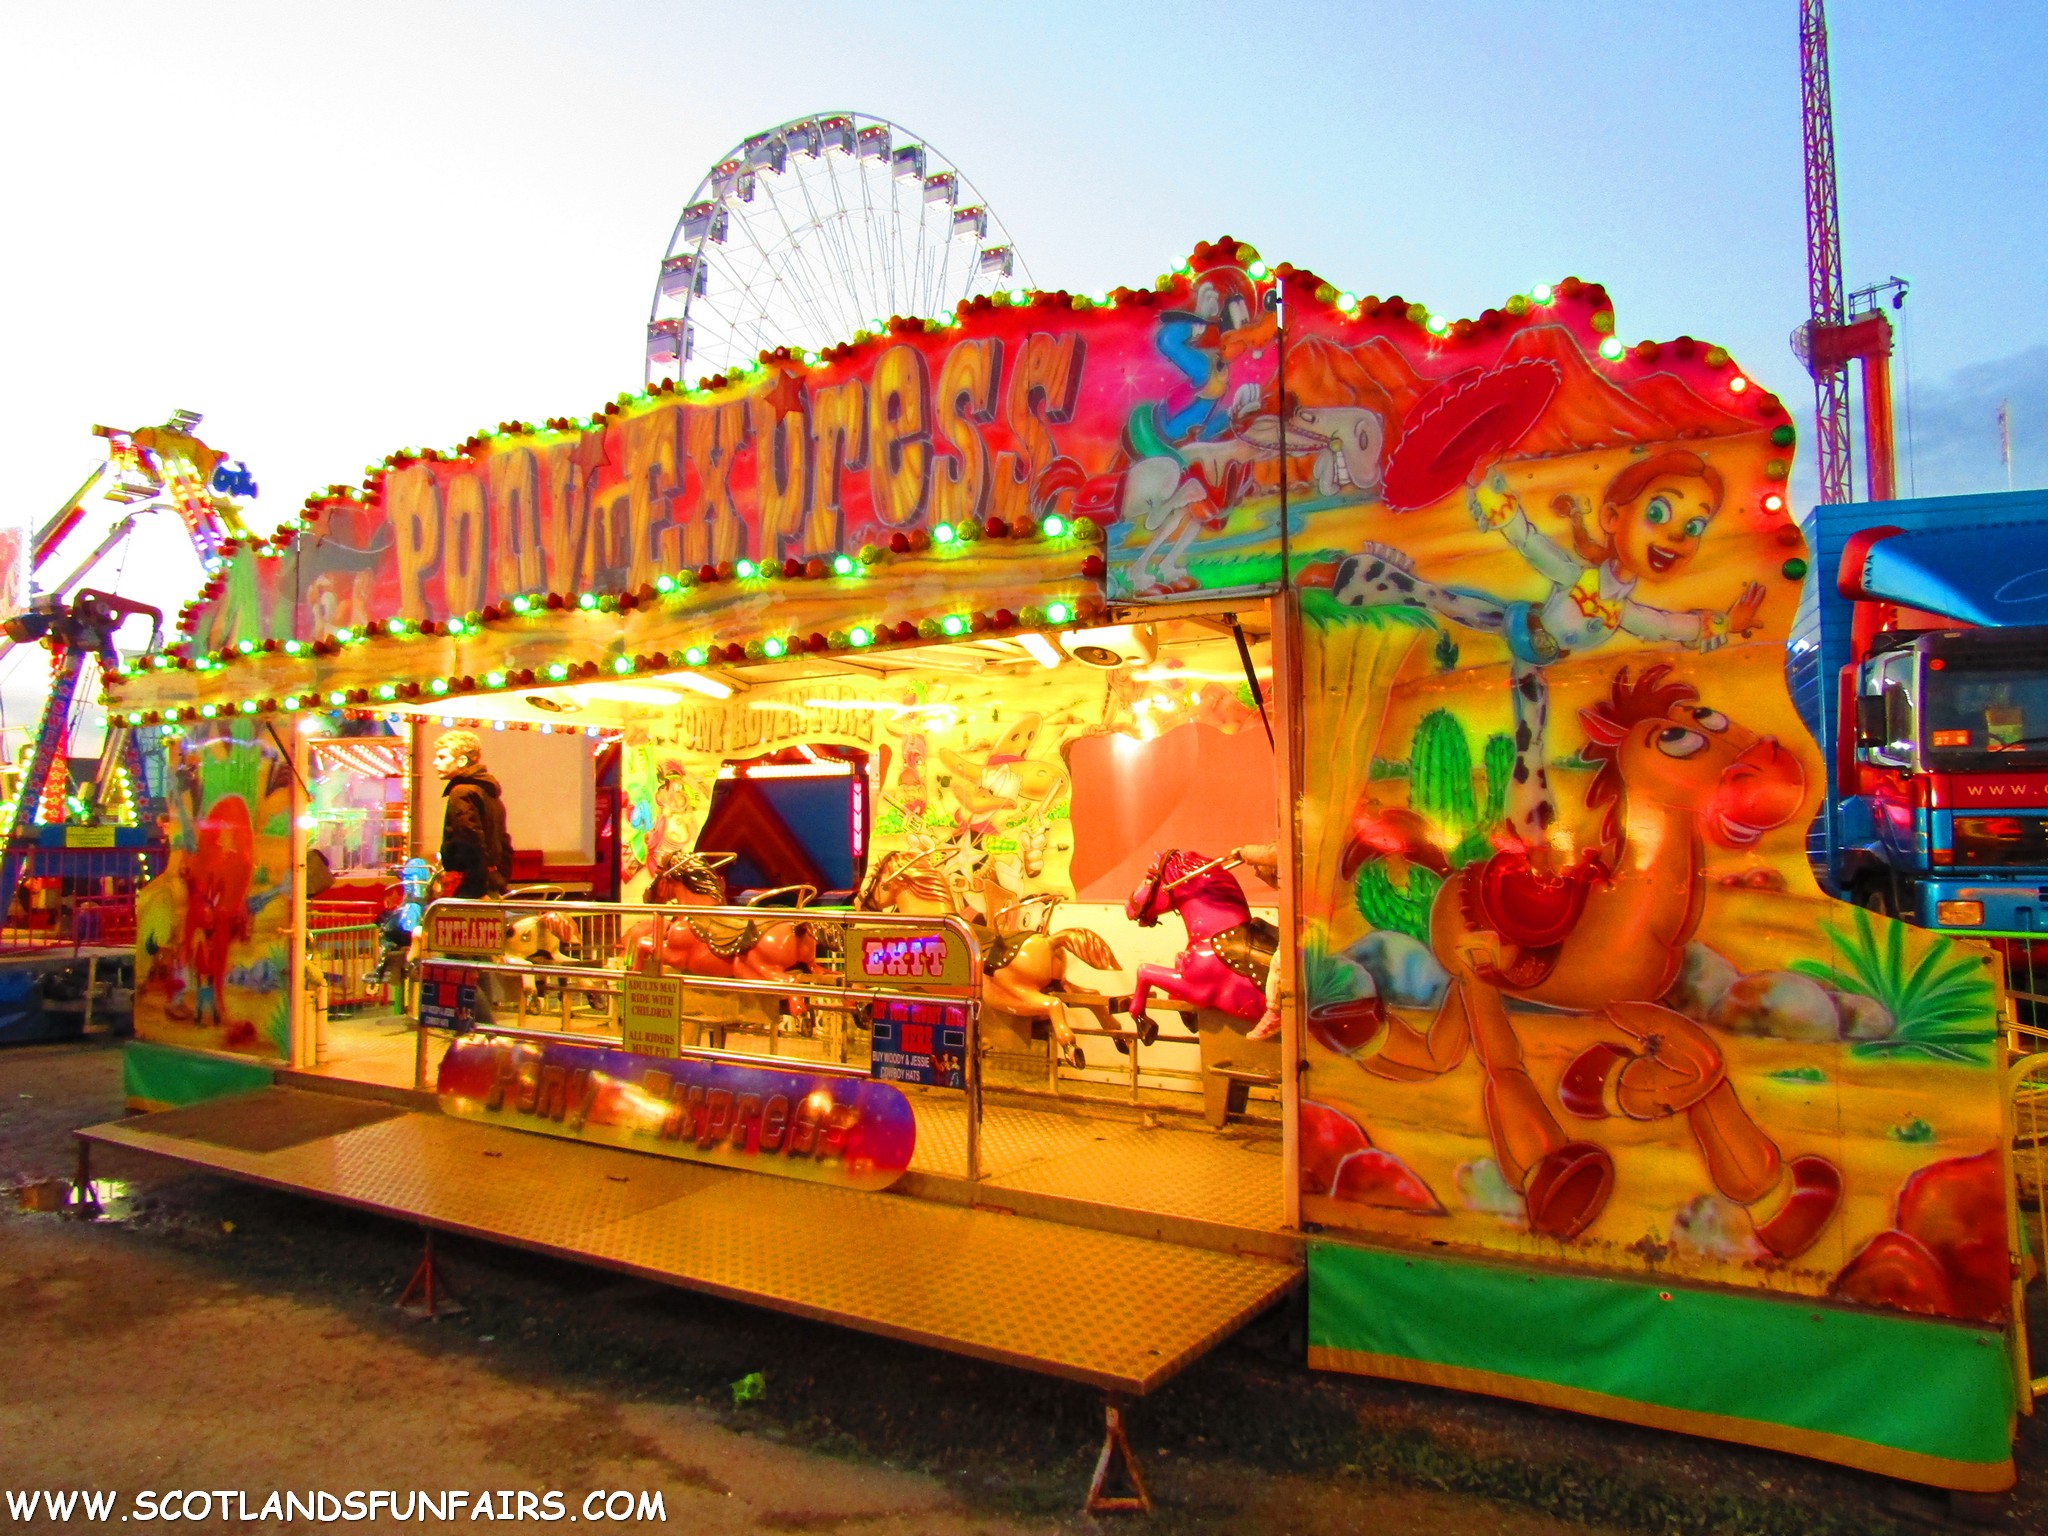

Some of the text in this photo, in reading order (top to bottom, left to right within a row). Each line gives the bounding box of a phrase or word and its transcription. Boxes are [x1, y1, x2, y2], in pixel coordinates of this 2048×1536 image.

[624, 334, 1087, 586] Express
[670, 684, 876, 752] PONY ADVENTURE
[436, 916, 502, 948] ENTRANCE
[862, 935, 948, 978] EXIT
[628, 980, 677, 993] ADULTS MAY
[631, 993, 674, 1006] RIDE WITH
[631, 1006, 672, 1018] CHILDREN
[629, 1031, 675, 1044] ALL RIDERS
[901, 1024, 933, 1054] HERE
[632, 1043, 670, 1056] MUST PAY
[872, 1050, 884, 1062] BUY
[884, 1052, 904, 1065] WOODY
[911, 1055, 931, 1068] JESSIE
[880, 1066, 921, 1082] COWBOY HATS
